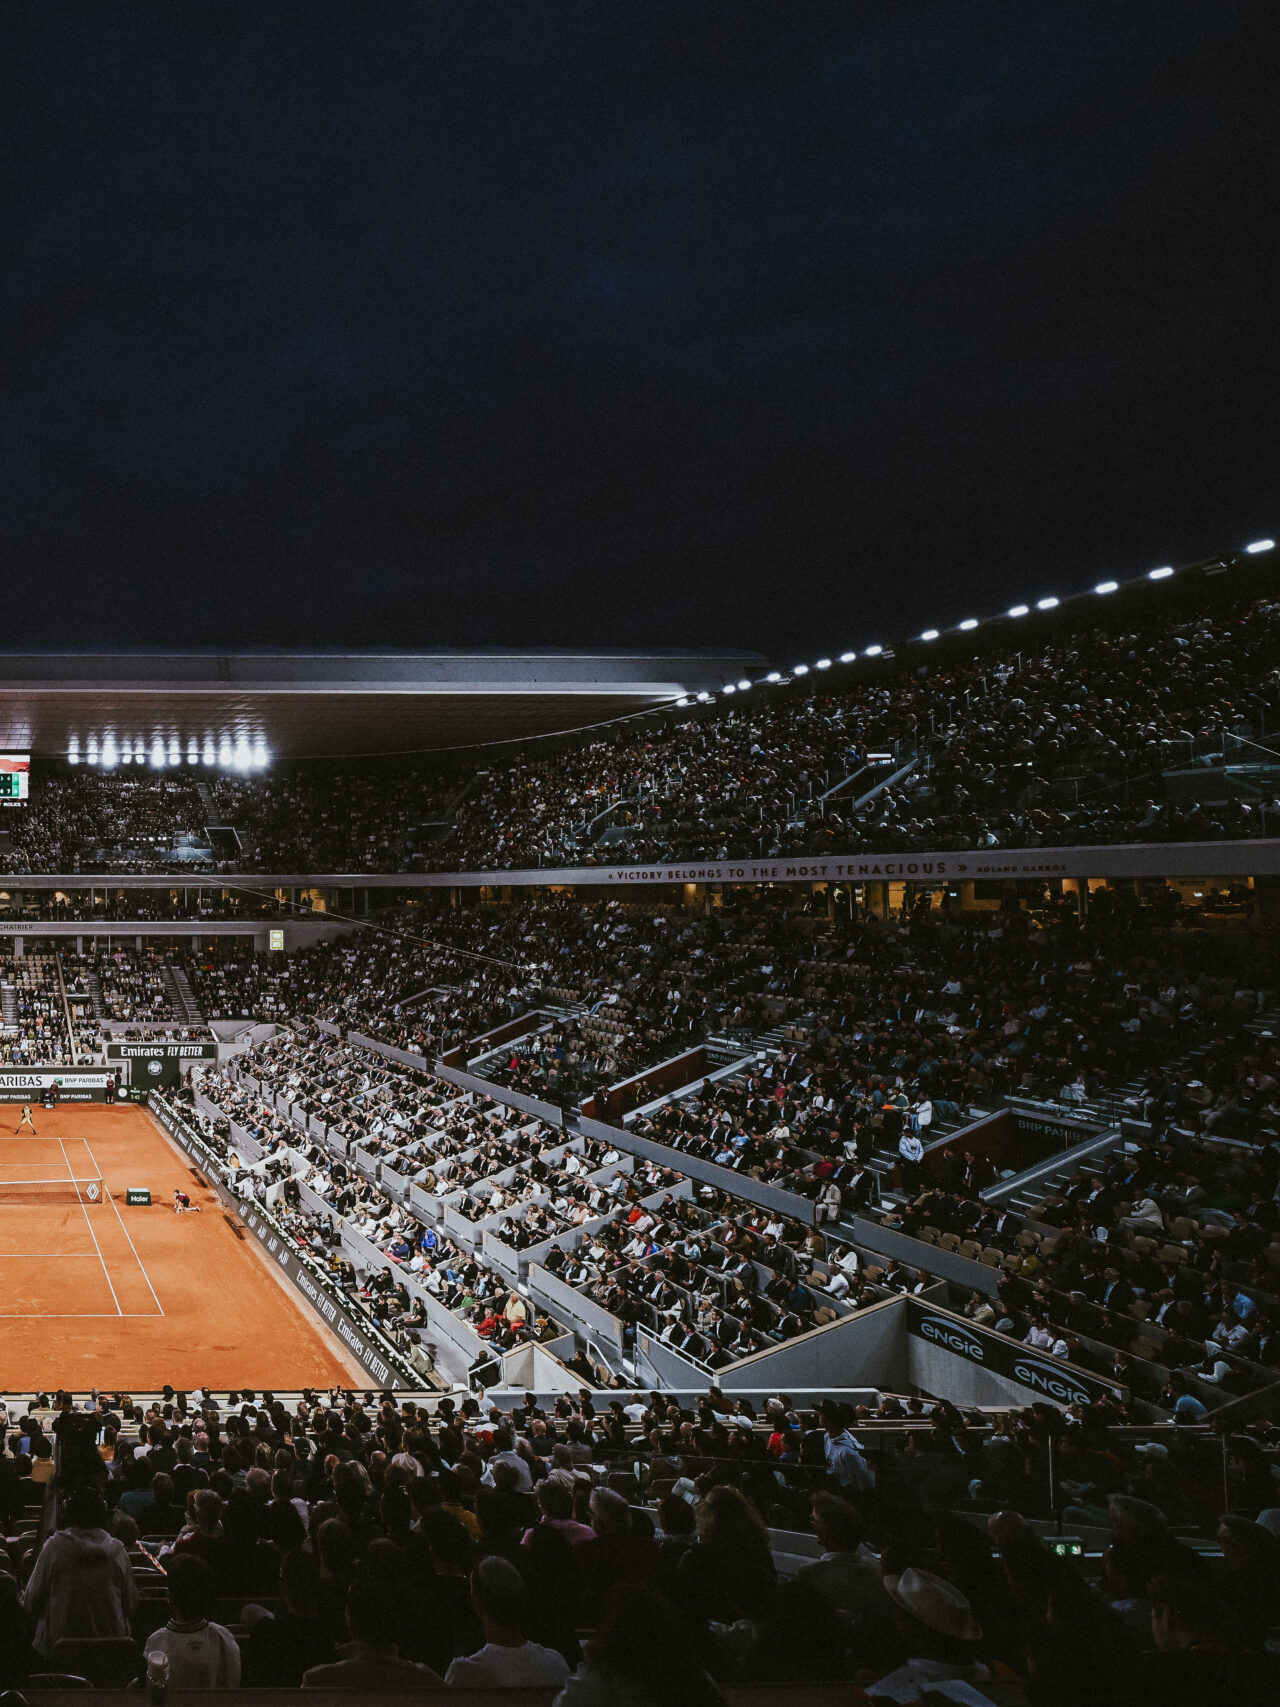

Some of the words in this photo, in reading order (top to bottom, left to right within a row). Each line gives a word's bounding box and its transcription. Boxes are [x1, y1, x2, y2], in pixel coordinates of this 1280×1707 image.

[618, 871, 662, 880] VICTORY
[668, 869, 722, 879] BELONGS
[729, 869, 744, 878] TO
[751, 867, 777, 877] THE
[786, 866, 828, 877] MOST
[837, 861, 946, 876] TENACIOUS
[1023, 864, 1066, 872] GARROS
[120, 1046, 164, 1056] Emirates
[167, 1046, 179, 1056] FLY
[179, 1046, 203, 1056] BETTER
[1017, 1119, 1042, 1131] BNP
[296, 1269, 318, 1300] Emirates
[316, 1293, 325, 1308] FLY
[322, 1299, 337, 1323] BETTER
[337, 1317, 364, 1356] Emirates
[363, 1347, 374, 1365] FLY
[370, 1355, 389, 1384] BETTER
